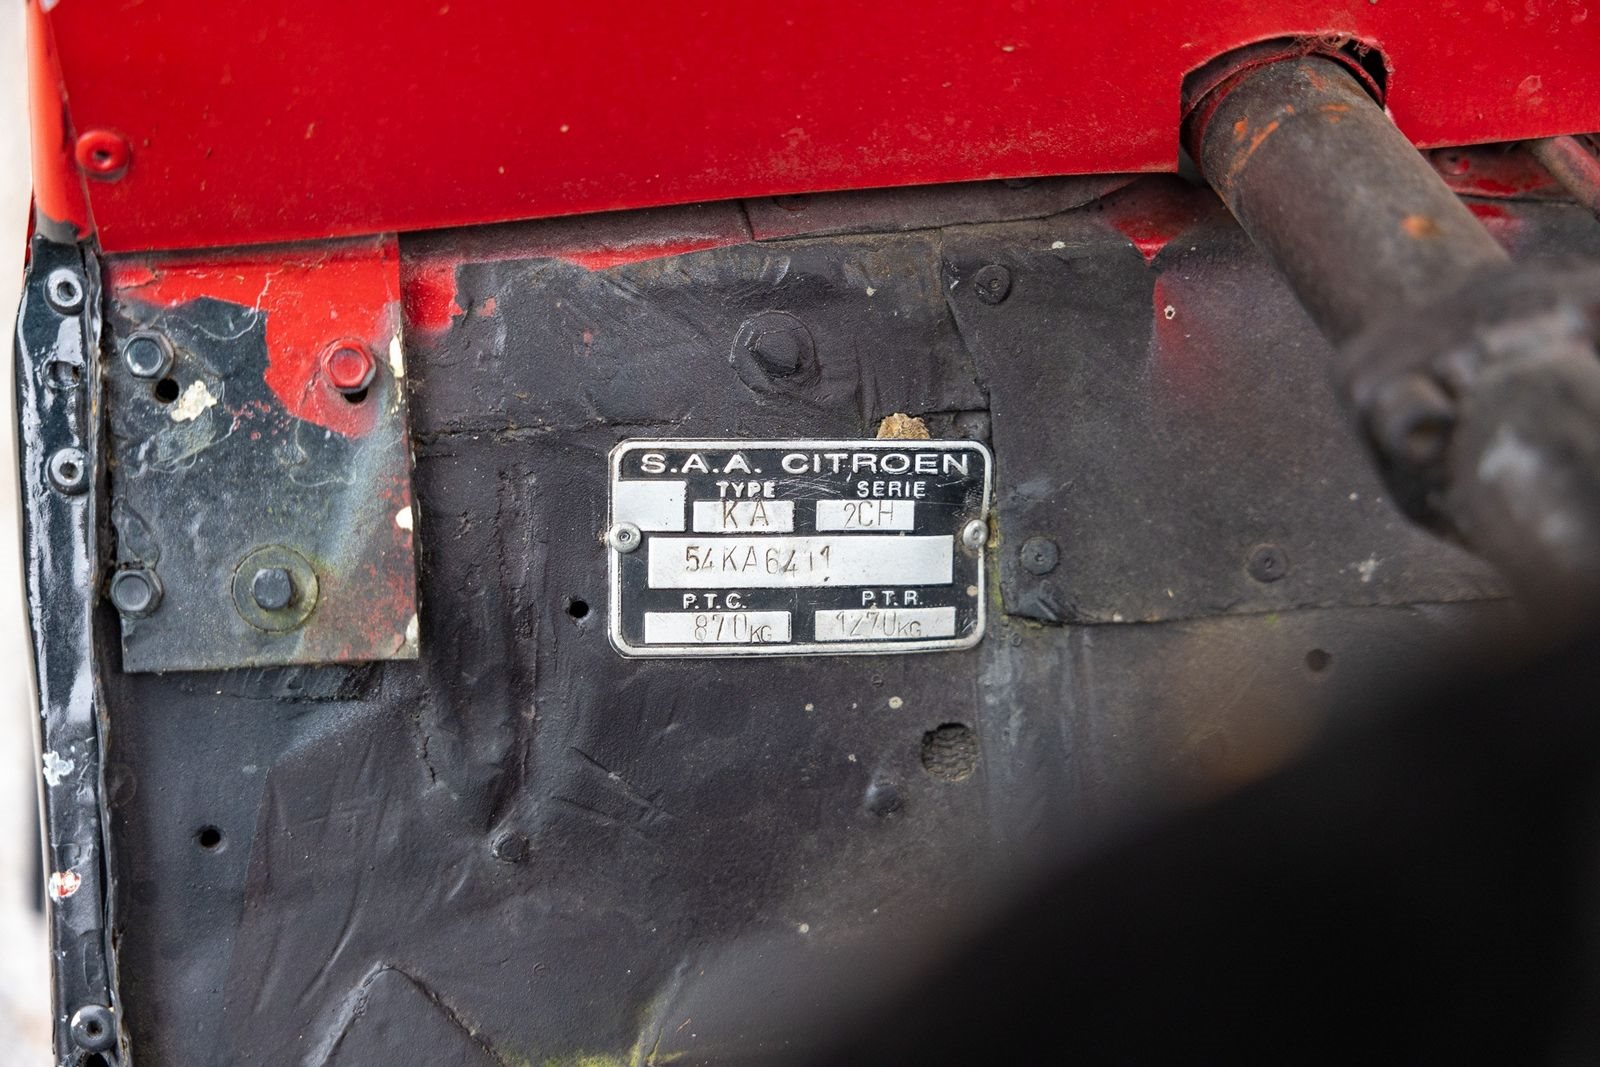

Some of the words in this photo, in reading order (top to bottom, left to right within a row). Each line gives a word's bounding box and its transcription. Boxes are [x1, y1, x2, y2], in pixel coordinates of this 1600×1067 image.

[640, 454, 762, 473] S.A.A.
[781, 453, 969, 474] CITROEN
[715, 480, 776, 498] TYPE
[857, 481, 926, 497] SERIE
[843, 500, 893, 528] 2CH
[683, 593, 747, 609] P.T.C.
[861, 589, 923, 606] P.T.R.
